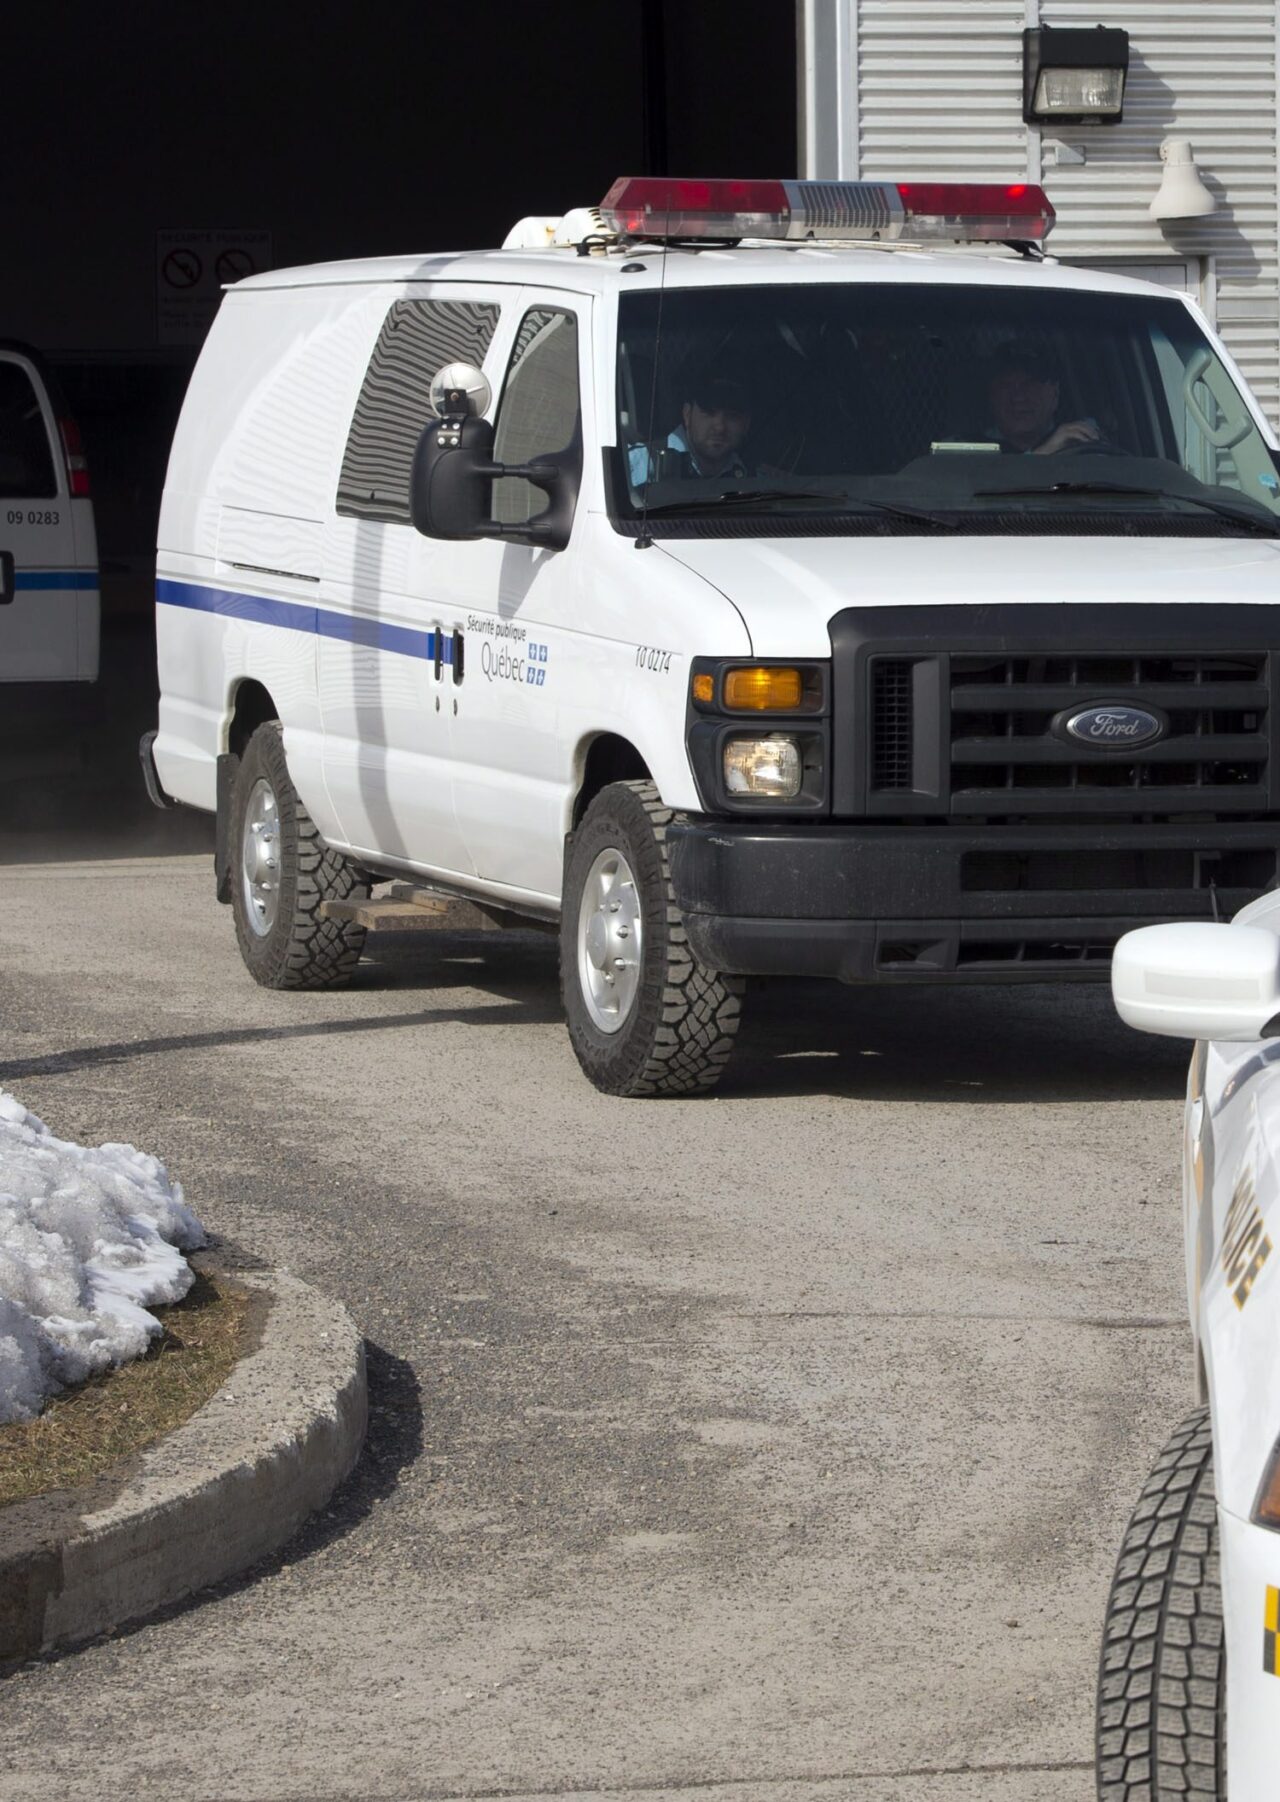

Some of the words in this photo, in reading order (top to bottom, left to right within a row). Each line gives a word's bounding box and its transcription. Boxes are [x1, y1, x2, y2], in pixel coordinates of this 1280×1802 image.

[7, 510, 23, 525] 09
[27, 511, 60, 525] 0283
[467, 614, 495, 636] Sécurité
[495, 621, 527, 644] publique
[481, 641, 526, 682] Québec
[635, 646, 648, 668] 10
[647, 648, 672, 675] 0274
[1090, 713, 1140, 736] Ford
